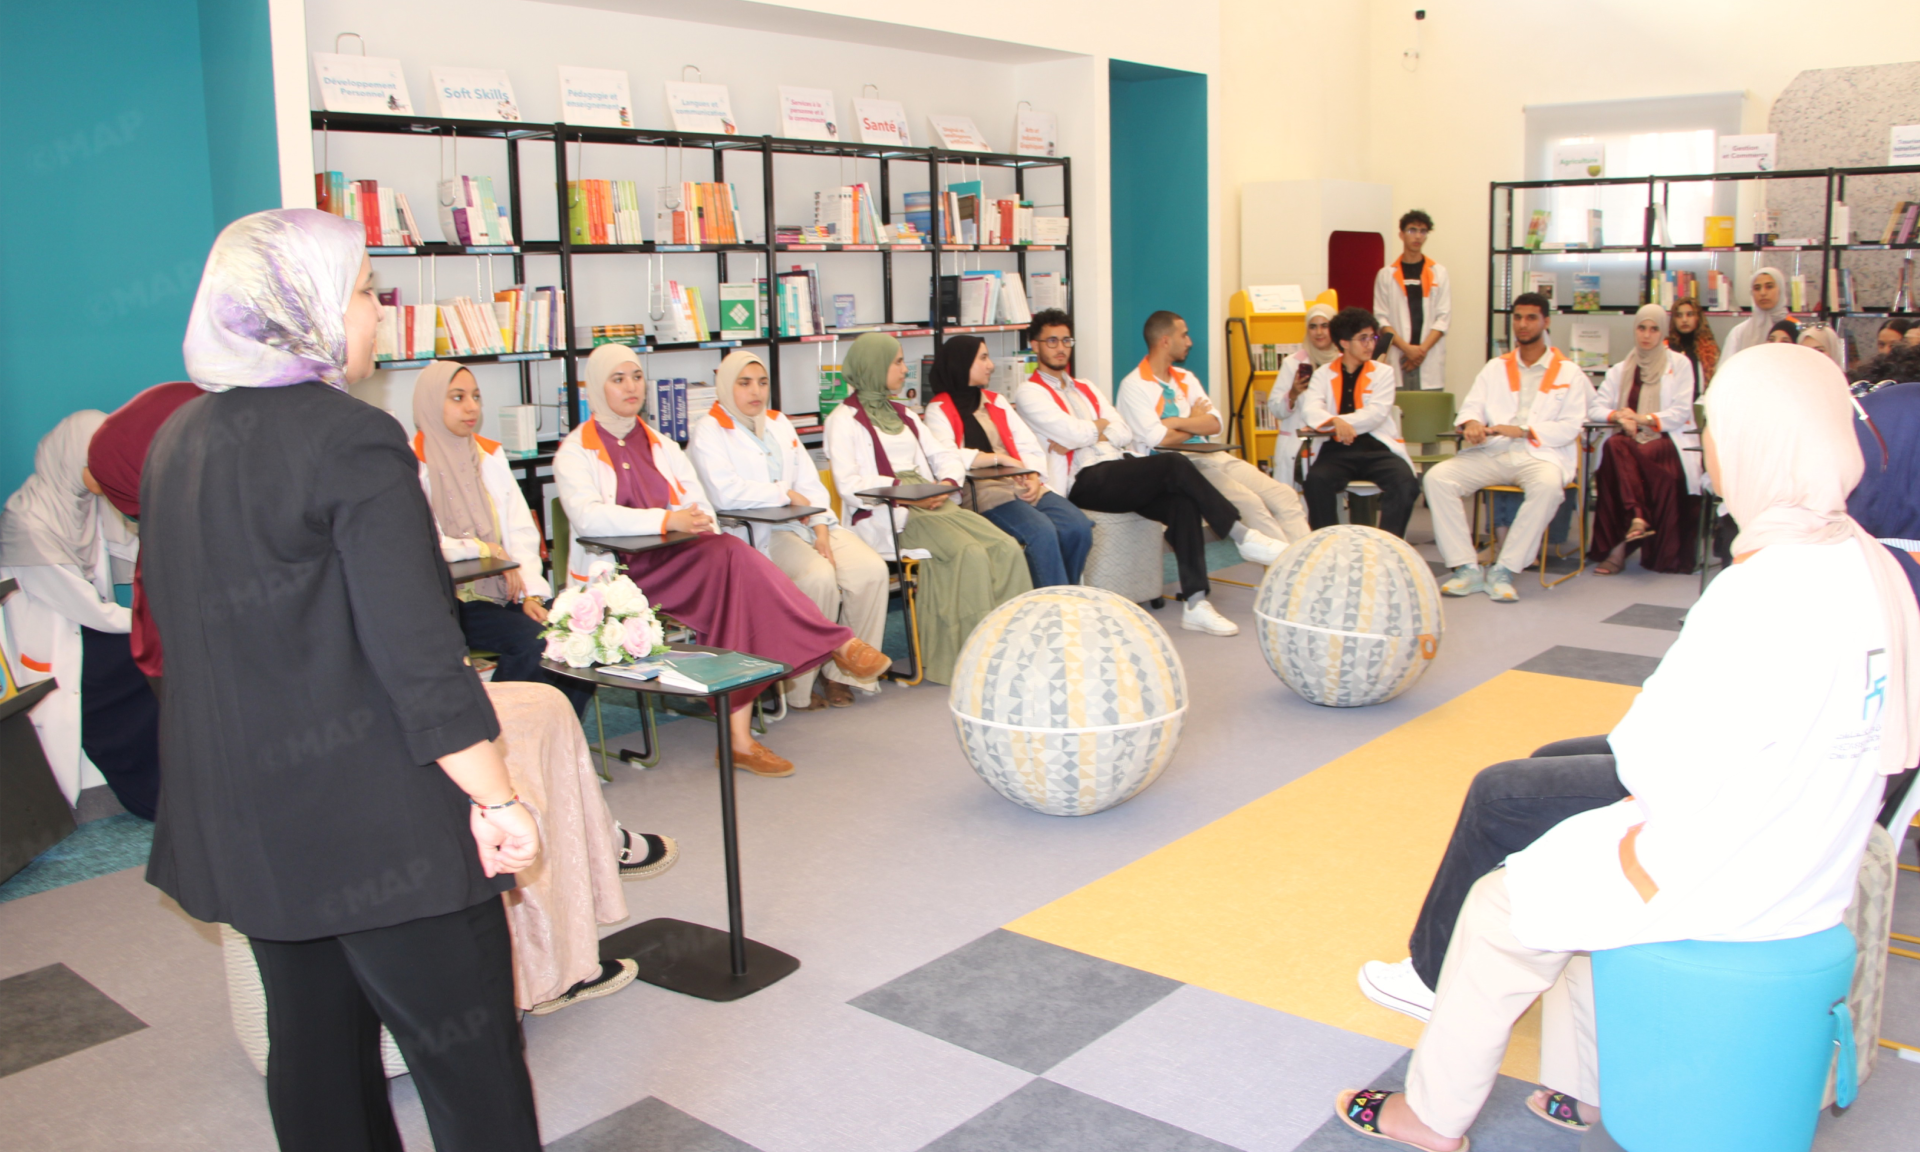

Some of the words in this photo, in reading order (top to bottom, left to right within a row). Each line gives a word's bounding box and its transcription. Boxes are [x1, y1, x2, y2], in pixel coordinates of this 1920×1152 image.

[323, 76, 397, 90] Développement
[340, 87, 386, 98] Personnel
[444, 87, 473, 99] Soft
[474, 88, 510, 101] Skills
[567, 89, 609, 101] Pédagogie
[610, 93, 618, 101] et
[566, 100, 620, 110] enseignement
[863, 117, 897, 133] Santé
[1732, 144, 1759, 152] Gestion
[1559, 157, 1599, 167] Agriculture
